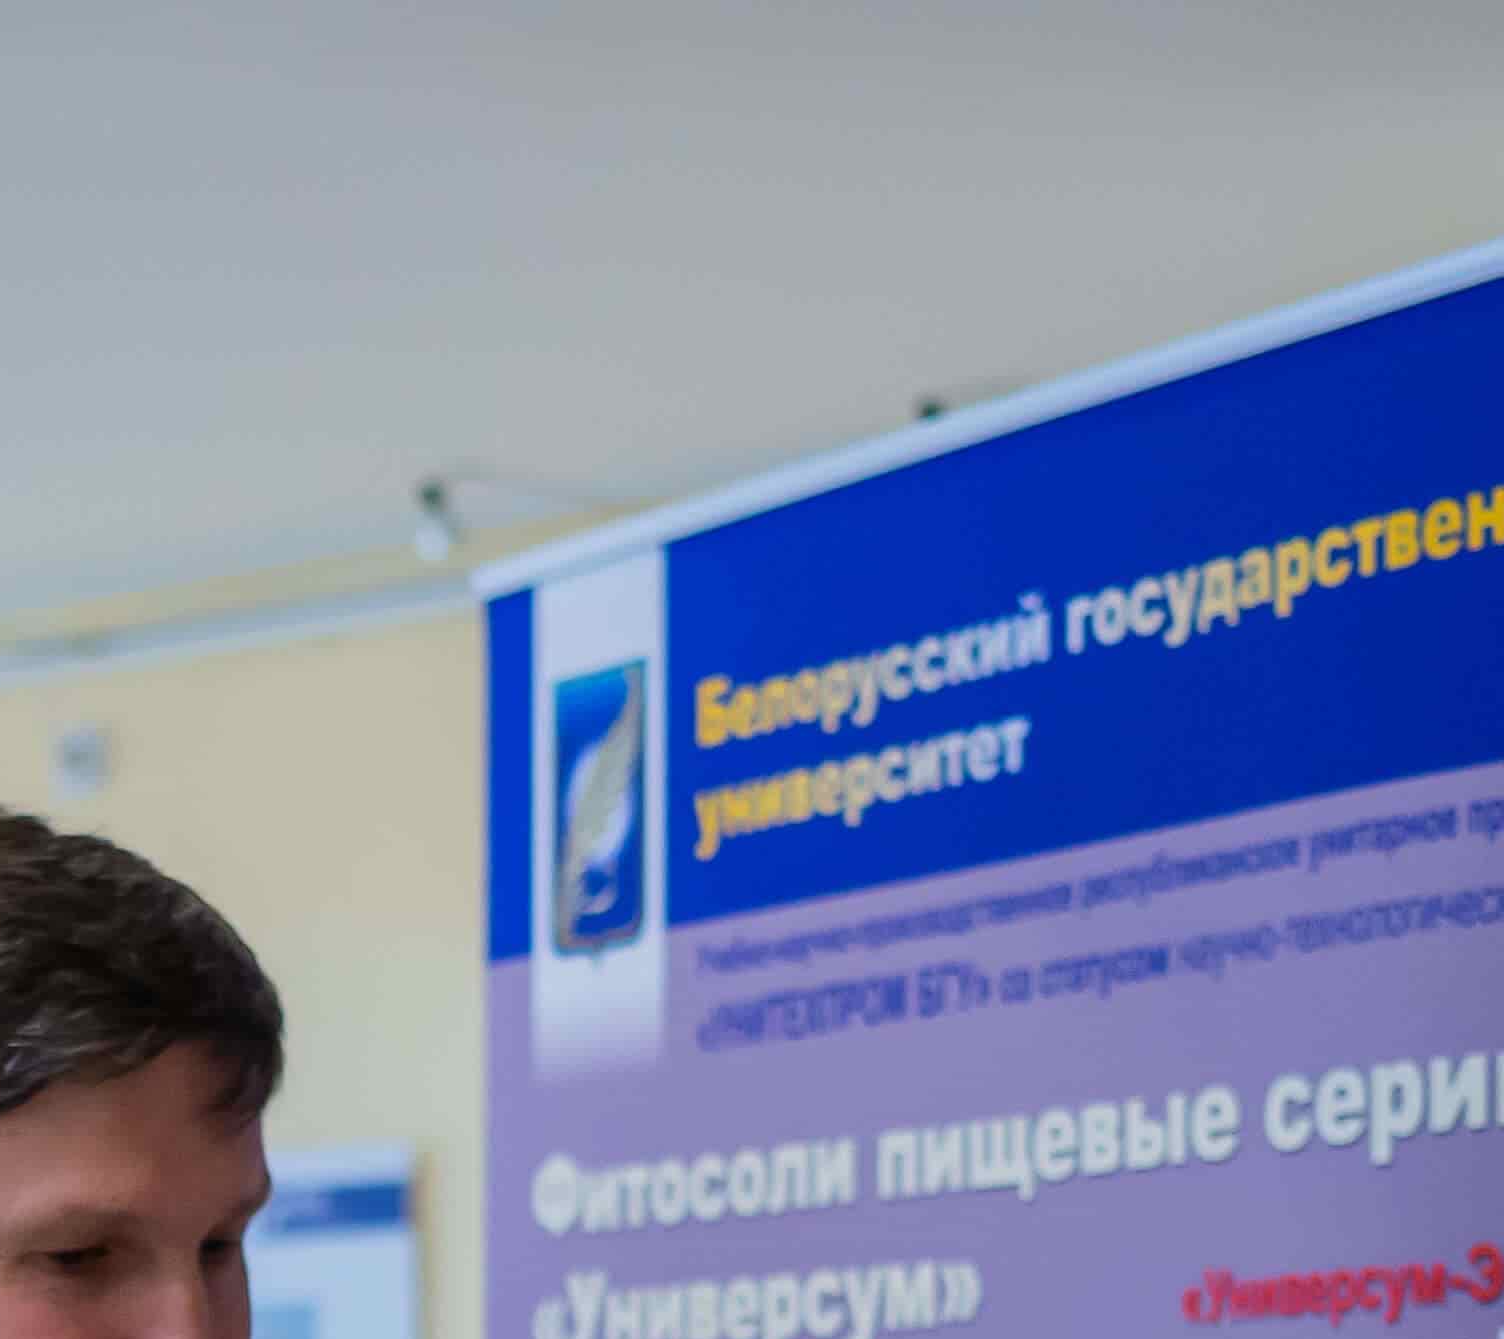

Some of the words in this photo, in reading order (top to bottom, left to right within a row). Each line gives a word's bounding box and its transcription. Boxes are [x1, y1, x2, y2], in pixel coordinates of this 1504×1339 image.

[696, 593, 1050, 746] Белорусский
[696, 714, 1030, 860] университет
[1000, 967, 1032, 1005] со
[1039, 945, 1170, 1000] статусом
[531, 1150, 857, 1238] Фитосоли
[877, 1086, 1240, 1201] пищевые
